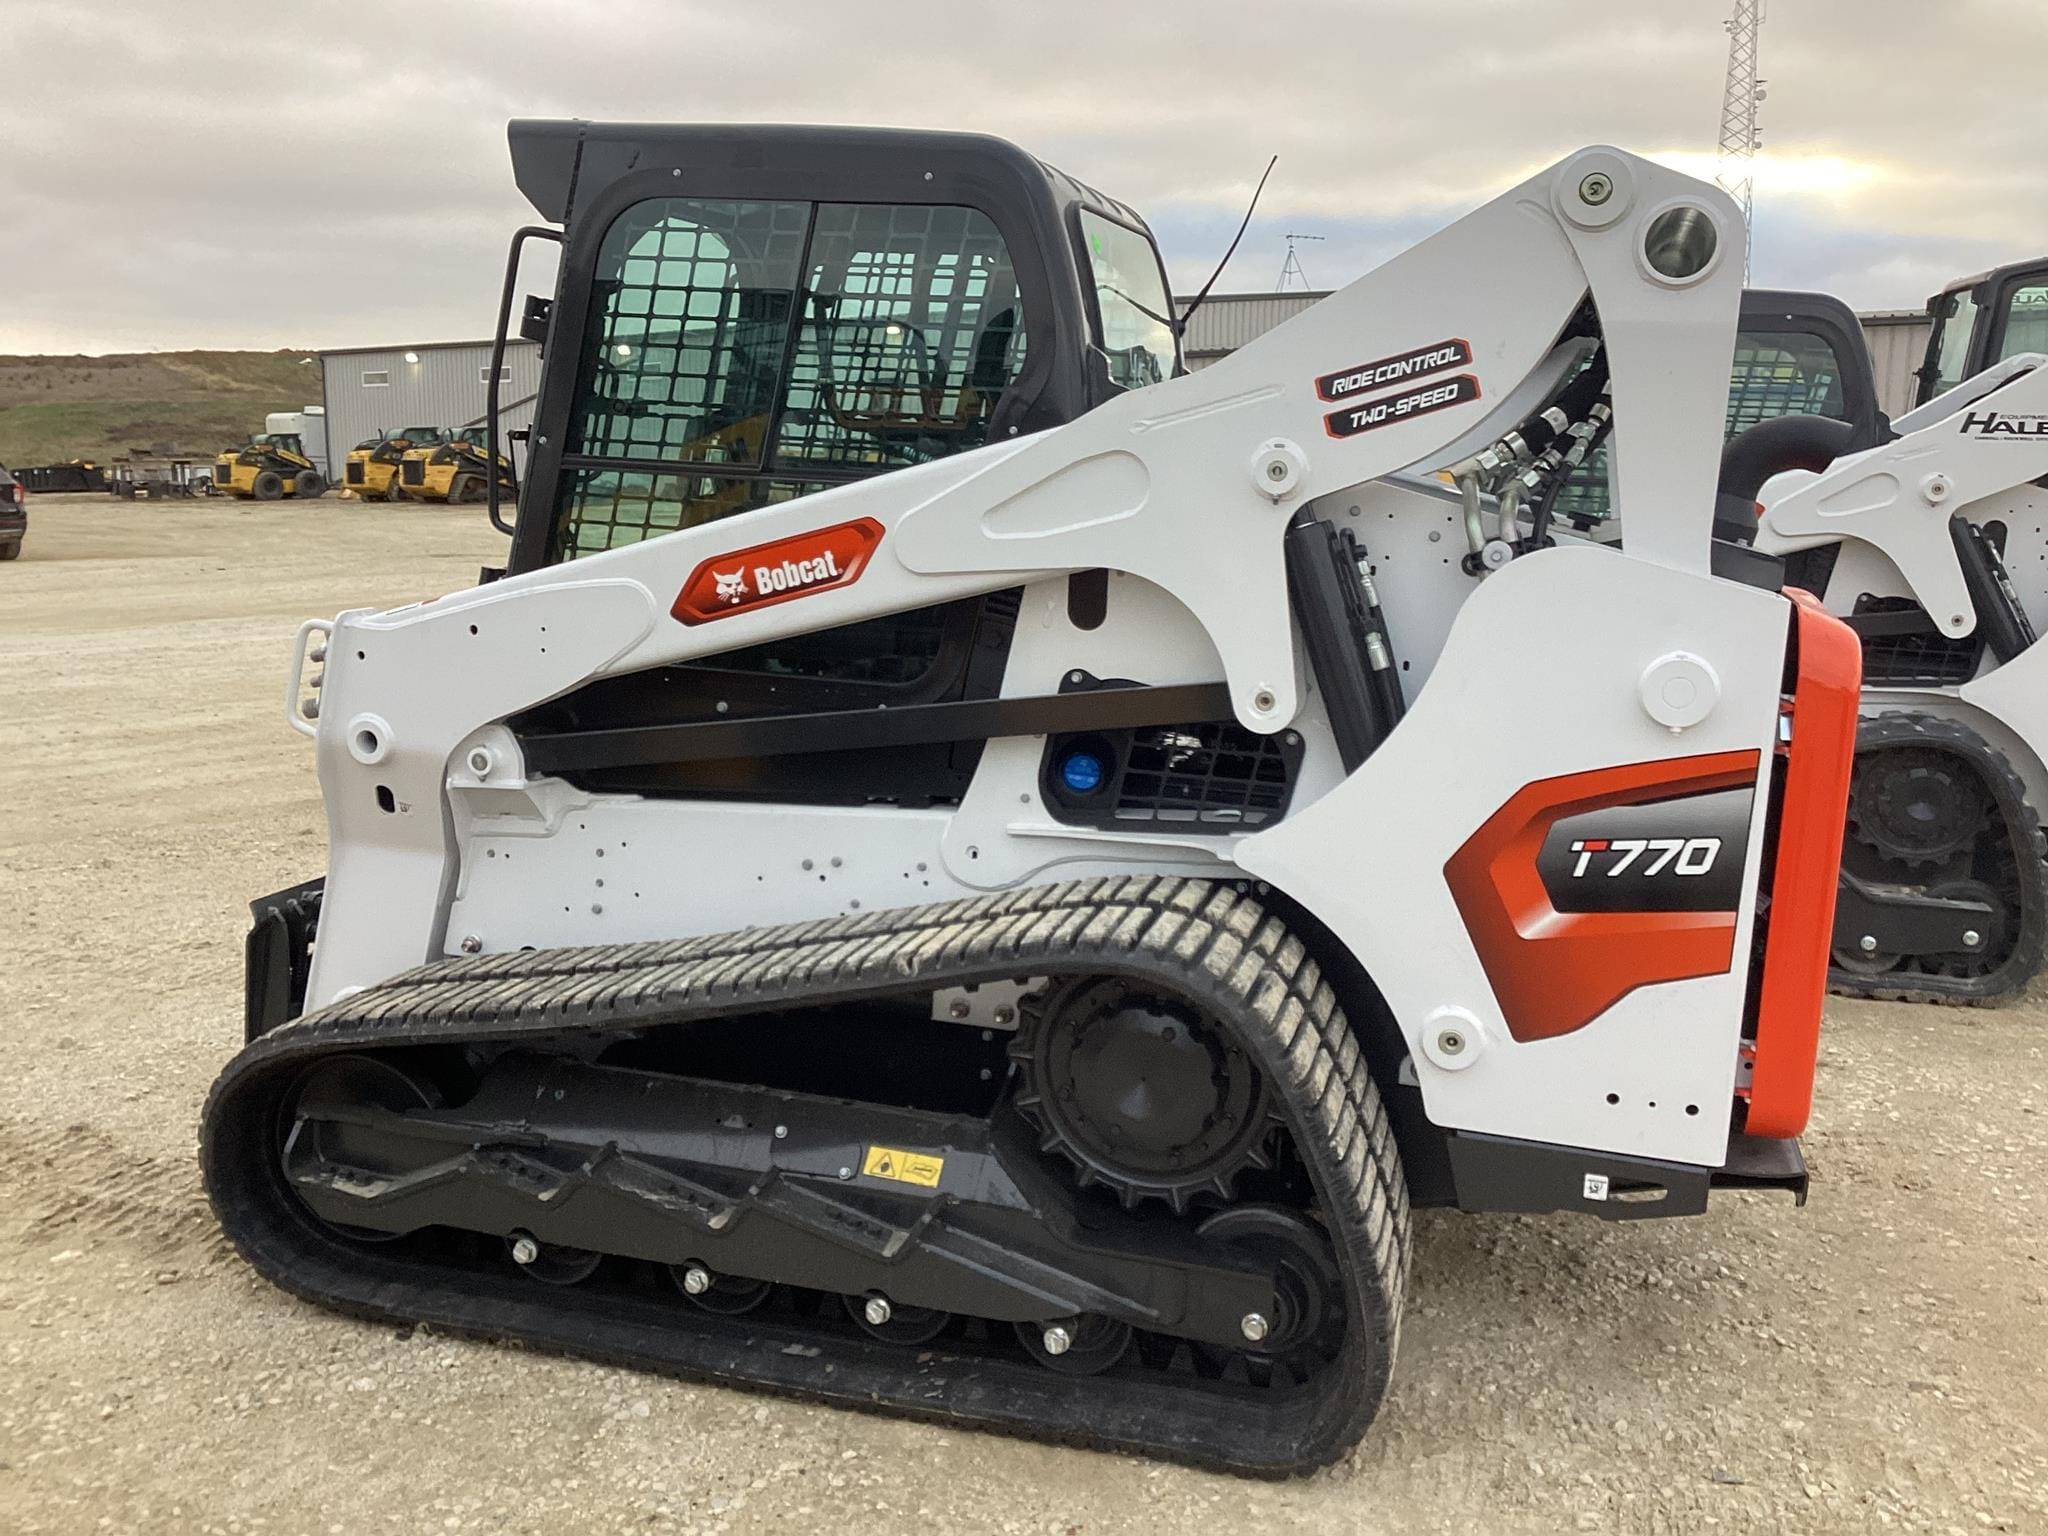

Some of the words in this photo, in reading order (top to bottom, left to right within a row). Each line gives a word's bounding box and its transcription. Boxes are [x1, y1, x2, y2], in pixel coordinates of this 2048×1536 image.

[1351, 384, 1459, 428] TWO-SPEED
[754, 550, 838, 595] Bobcat
[1571, 838, 1722, 877] T770
